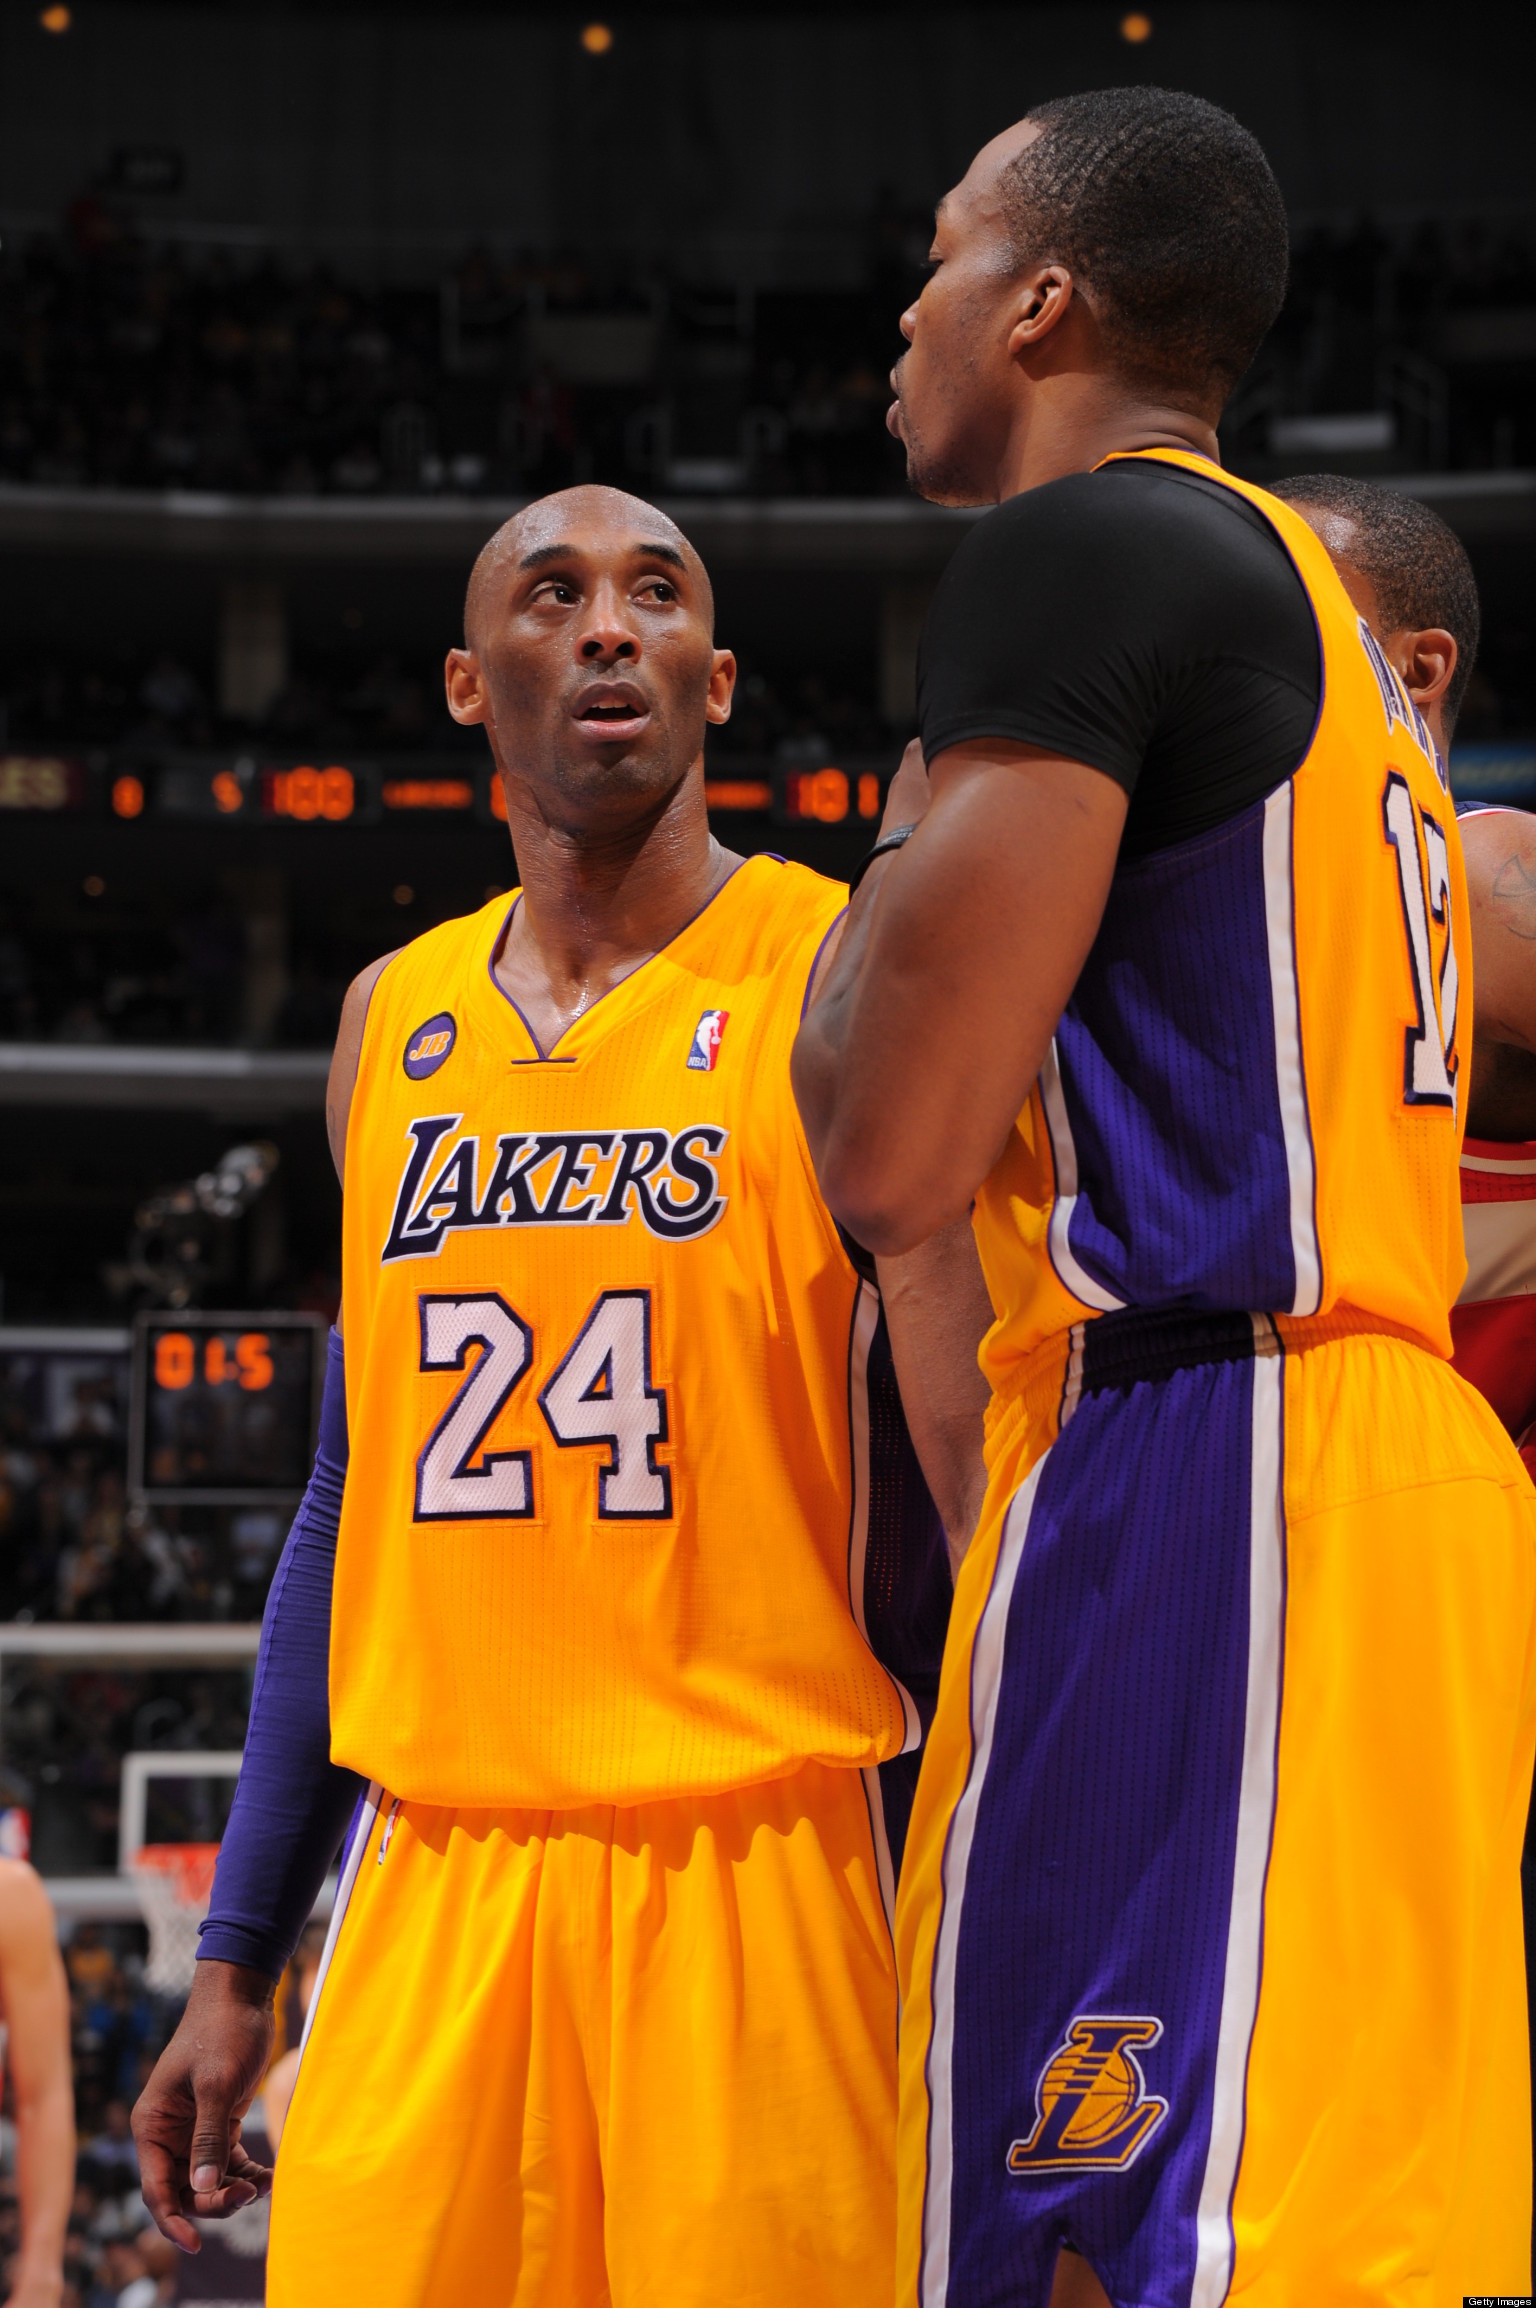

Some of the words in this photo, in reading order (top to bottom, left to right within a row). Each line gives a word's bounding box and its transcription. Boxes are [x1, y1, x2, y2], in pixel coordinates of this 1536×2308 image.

[0, 757, 67, 811] ES
[1383, 769, 1459, 1107] 12
[409, 1031, 451, 1061] JB
[687, 1056, 707, 1069] NBA
[381, 1113, 730, 1268] LAKERS
[413, 1289, 673, 1522] 24
